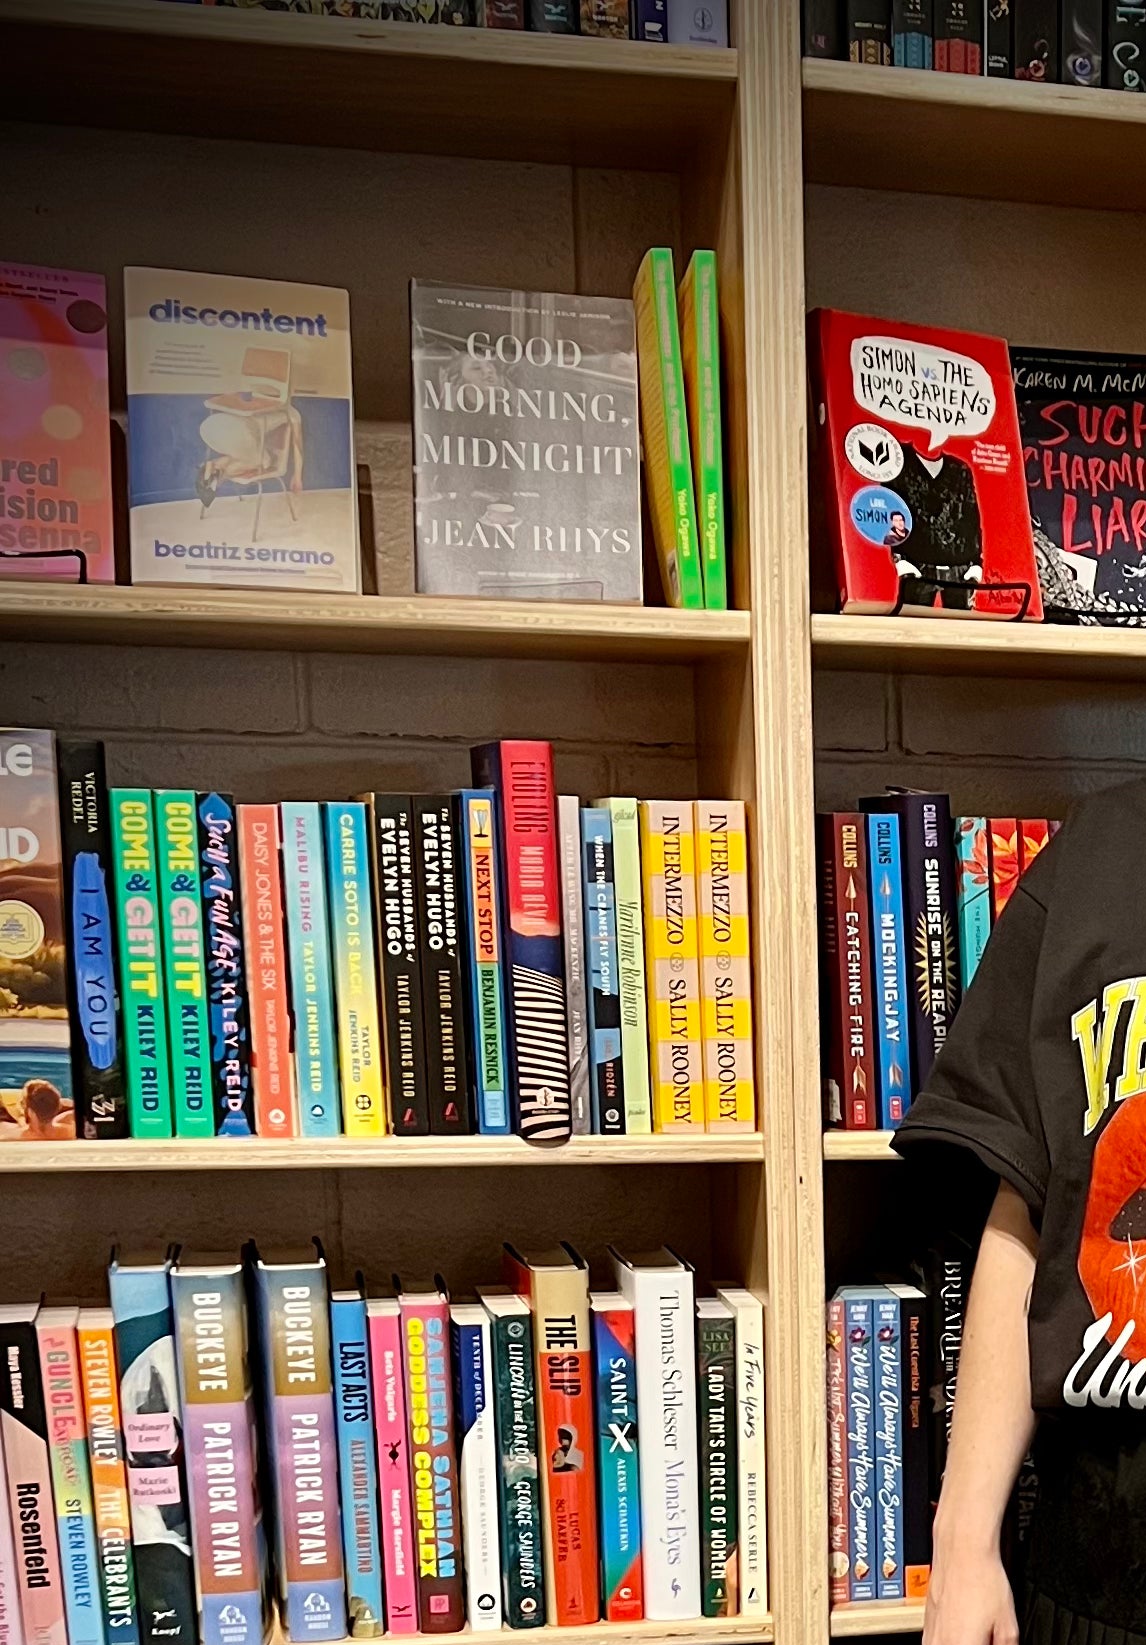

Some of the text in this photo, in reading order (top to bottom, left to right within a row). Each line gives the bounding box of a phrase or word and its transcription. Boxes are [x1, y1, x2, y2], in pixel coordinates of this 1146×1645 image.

[148, 299, 327, 338] discontent
[466, 331, 582, 369] GOOD
[423, 380, 632, 428] MORNING,
[861, 373, 990, 415] HOMO SAPIENS
[862, 346, 915, 376] SIMON
[938, 359, 975, 387] THE
[879, 395, 967, 426] AGENDA
[1014, 368, 1066, 389] KAREN
[1073, 374, 1097, 393] M.
[420, 434, 631, 476] MIDNIGHT
[154, 540, 335, 566] beatriz serrano
[424, 519, 631, 554] JEAN RHYS
[71, 781, 83, 824] REDEL
[85, 772, 98, 833] VICTORIA
[511, 762, 547, 833] ENDLING
[381, 818, 402, 955] EVELYN HUGO
[423, 813, 444, 950] EVELYN HUGO
[476, 854, 493, 954] NEXT STOP
[663, 816, 692, 1123] INTERMEZZO SALLY ROONEY
[710, 815, 737, 1122] INTERMEZZO SALLY ROONEY
[842, 825, 864, 1057] COLLINS CATCHING FIRE
[877, 822, 900, 1042] COLLINS MOCKINGJAY
[192, 1292, 228, 1392] BUCKEYE
[283, 1286, 315, 1383] BUCKEYE
[545, 1315, 581, 1396] THE SLIP
[85, 1339, 118, 1467] STEVEN ROWLEY
[340, 1341, 368, 1422] LAST ACTS
[608, 1358, 633, 1453] SAINT X
[291, 1413, 327, 1565] PATRICK RYAN
[408, 1317, 437, 1578] GODDESS COMPLEX
[17, 1482, 50, 1589] Rosenfeld
[202, 1421, 243, 1578] PATRICK RYAN
